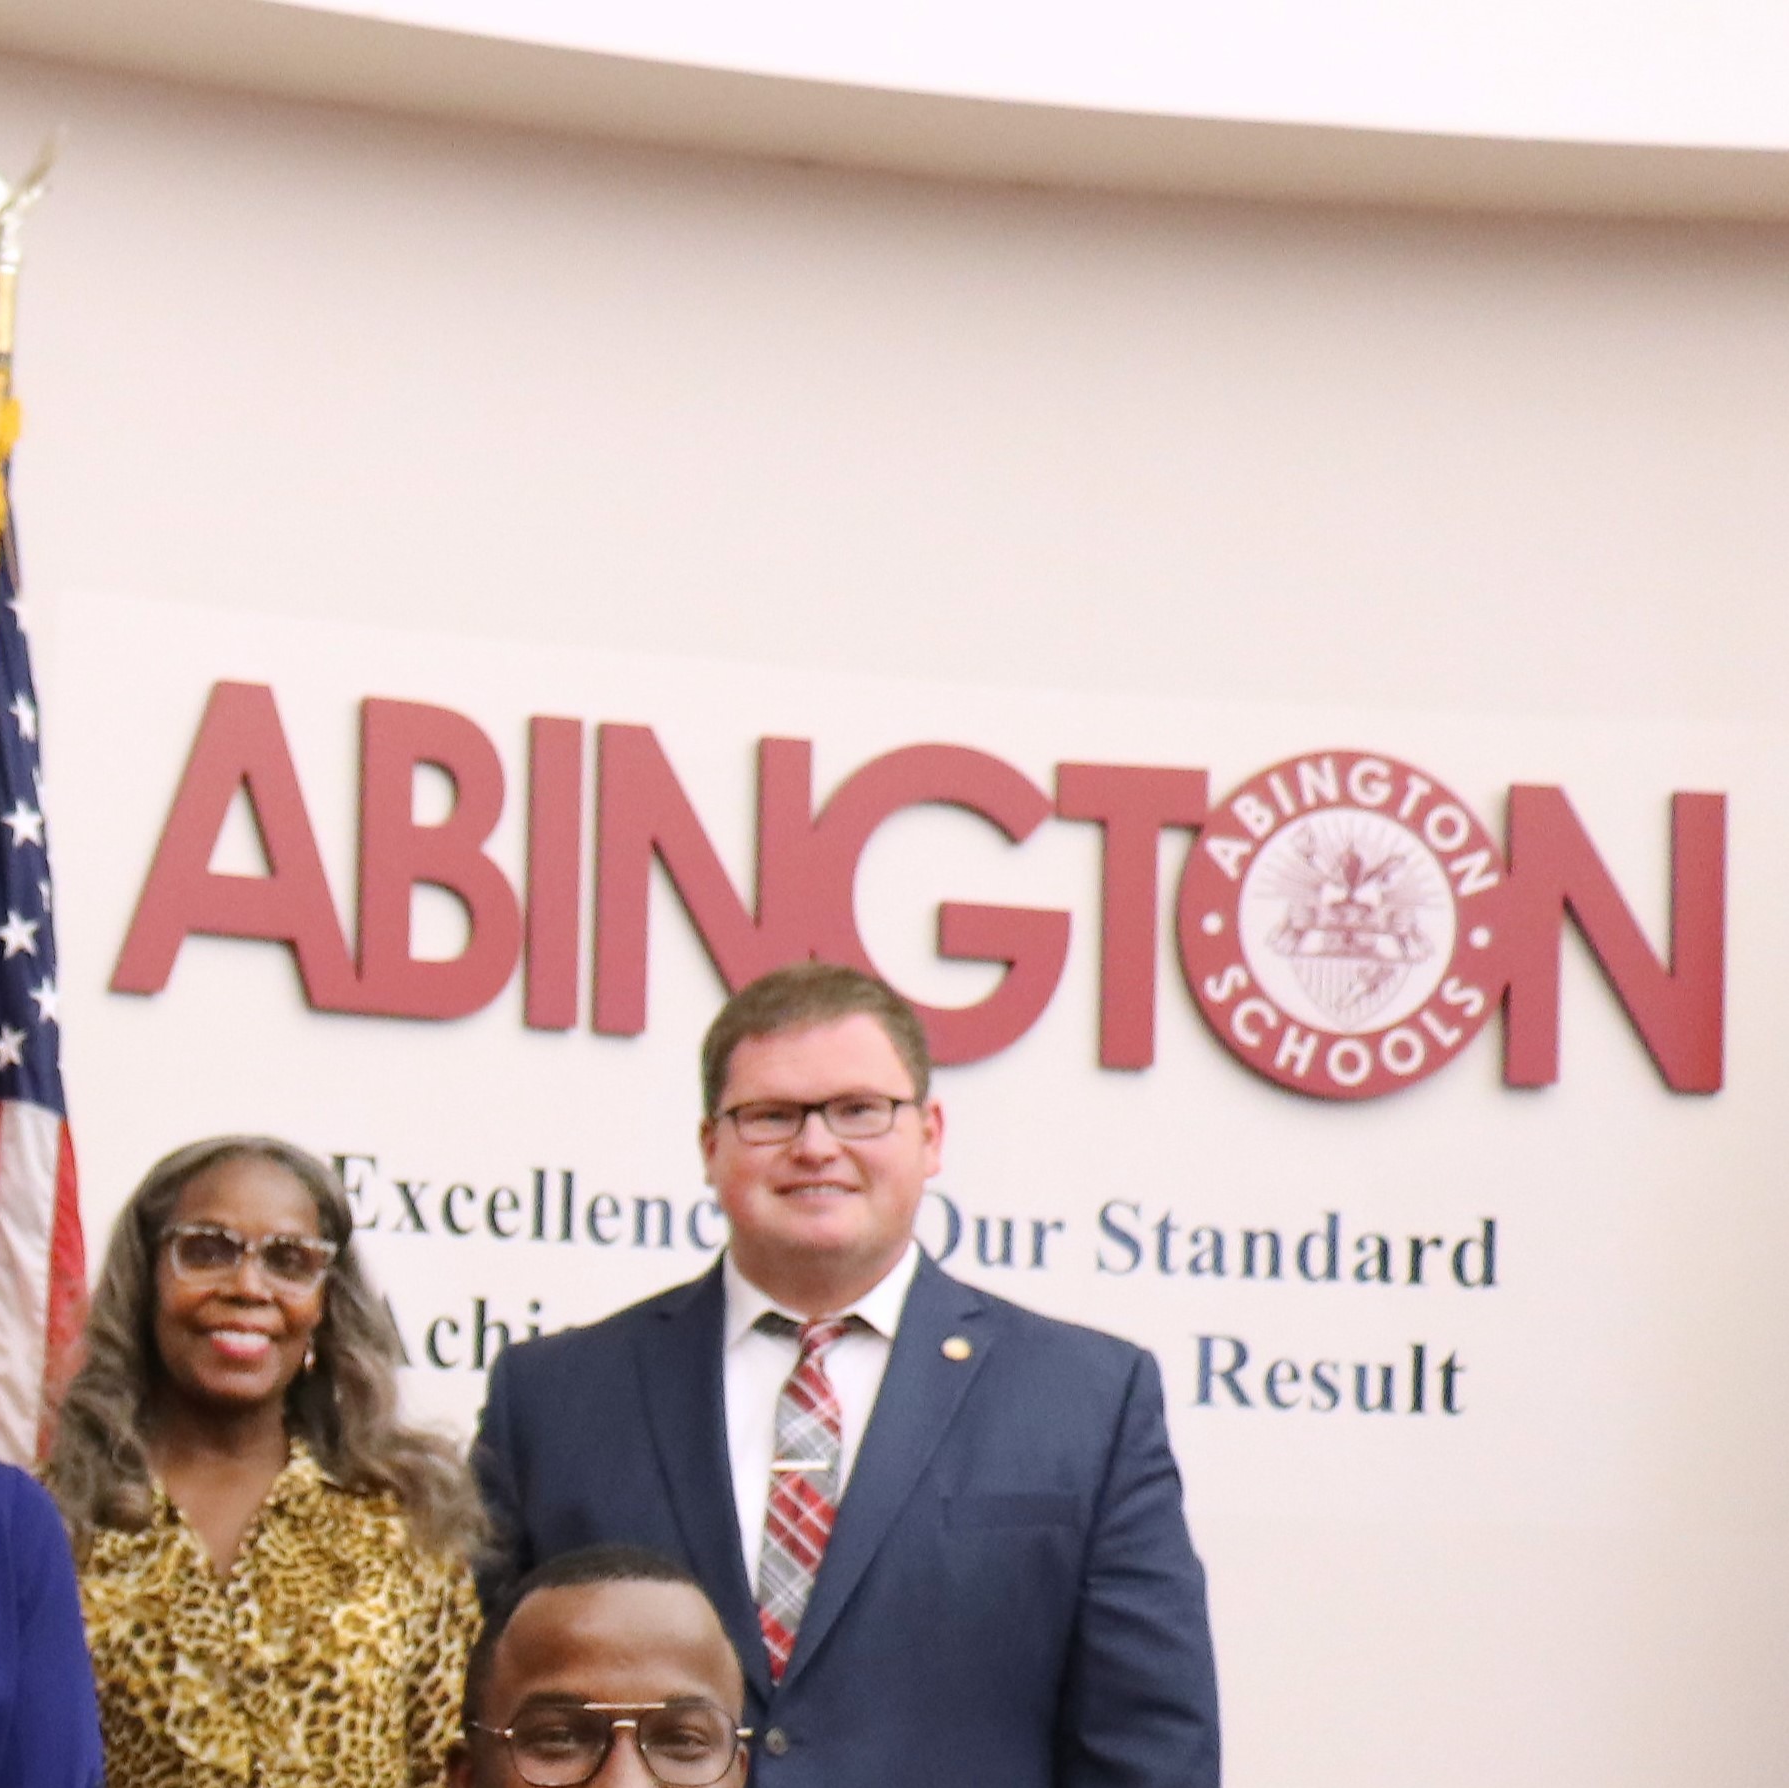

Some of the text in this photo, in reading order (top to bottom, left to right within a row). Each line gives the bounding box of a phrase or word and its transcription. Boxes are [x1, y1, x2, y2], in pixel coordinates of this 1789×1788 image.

[108, 679, 1727, 1100] ABINGTON
[1204, 757, 1500, 898] ABINGTON
[1202, 964, 1486, 1087] SCHOOLS
[332, 1153, 728, 1251] Excellenc
[1095, 1198, 1499, 1289] Standard
[1191, 1334, 1467, 1417] Result
